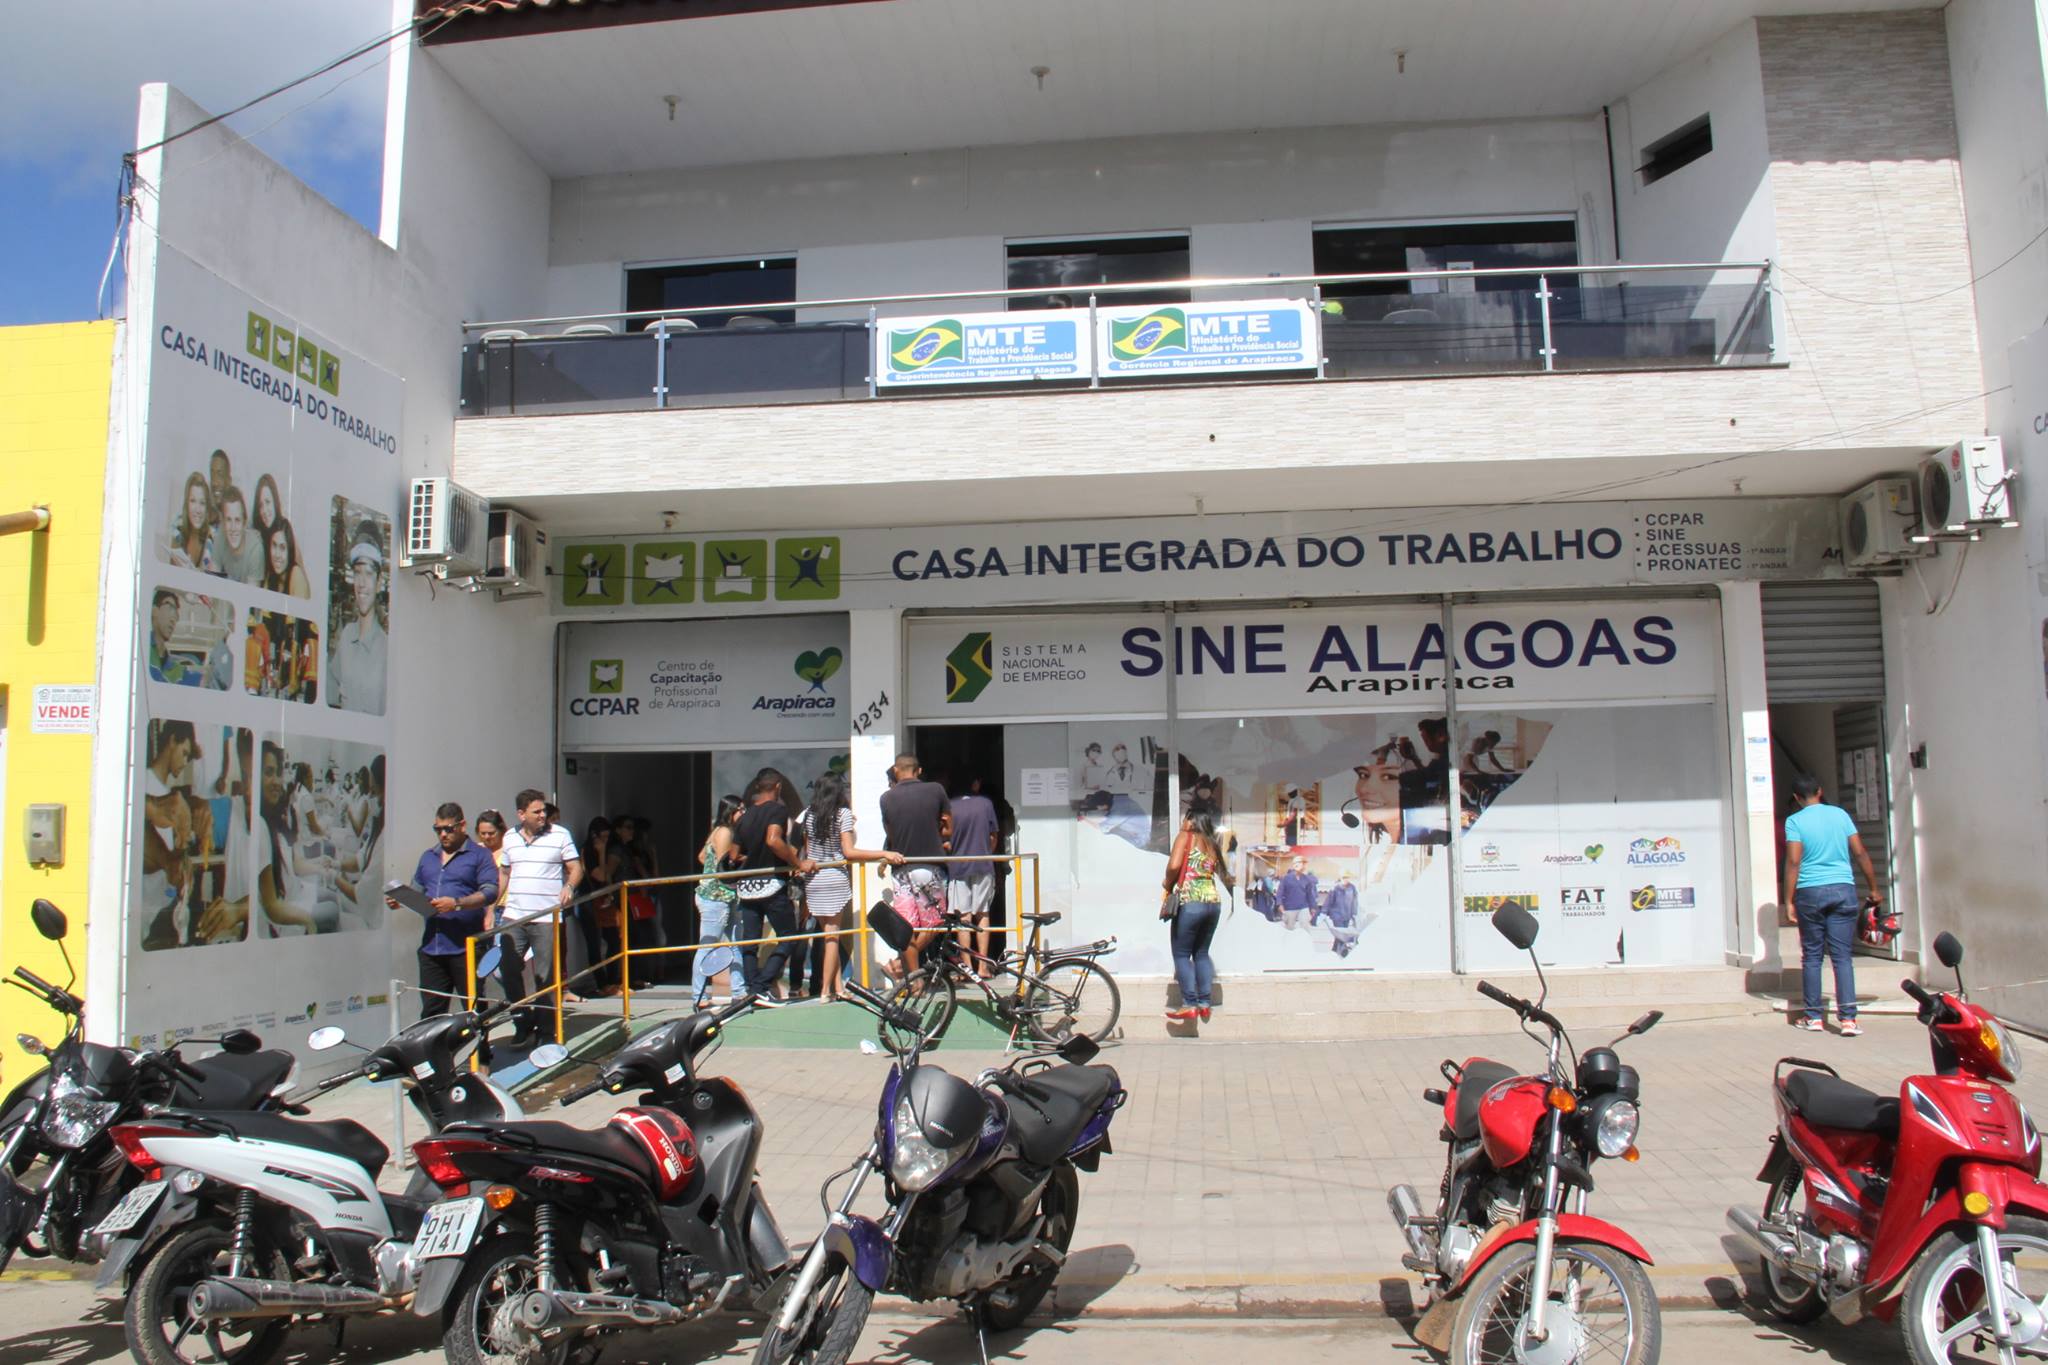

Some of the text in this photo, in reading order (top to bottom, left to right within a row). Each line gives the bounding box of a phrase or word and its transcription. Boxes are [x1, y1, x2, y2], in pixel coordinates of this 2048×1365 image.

[1190, 314, 1271, 335] MTE
[967, 325, 1046, 347] MTE
[1191, 334, 1259, 345] Ministério do
[968, 344, 1035, 356] Ministério do
[1051, 351, 1074, 361] Social
[1119, 355, 1296, 370] Gerência Regional de Arapiraca
[977, 367, 1018, 378] Regional
[1033, 366, 1072, 376] Alagoas
[161, 325, 397, 455] CASA INTEGRADA DO TRABALHO
[1645, 513, 1704, 526] CCPAR
[1646, 528, 1686, 541] SINE
[892, 527, 1622, 582] CASA INTEGRADA DO TRABALHO
[1647, 542, 1742, 556] ACESSUAS
[1647, 557, 1742, 571] PRONATEC
[1002, 643, 1087, 657] SISTEMA
[1120, 615, 1677, 677] SINE ALAGOAS
[657, 659, 715, 672] Centro de
[1002, 658, 1065, 669] NACIONAL
[650, 672, 723, 686] Capacitação
[1003, 669, 1086, 682] DE EMPREGO
[654, 685, 718, 697] Profissional
[1306, 673, 1515, 696] Arapiraca
[569, 697, 640, 716] CCPAR
[649, 698, 721, 711] de Arapiraca
[752, 695, 836, 712] Arapiraca
[38, 705, 90, 719] VENDE
[853, 690, 890, 735] 1234
[1543, 854, 1583, 863] Arapiraca
[1627, 851, 1686, 864] ALAGOAS
[1561, 888, 1605, 904] FAT
[1657, 888, 1682, 900] MTE
[659, 1137, 682, 1176] HONDA
[335, 1212, 363, 1221] HONDA
[417, 1233, 461, 1256] 7141
